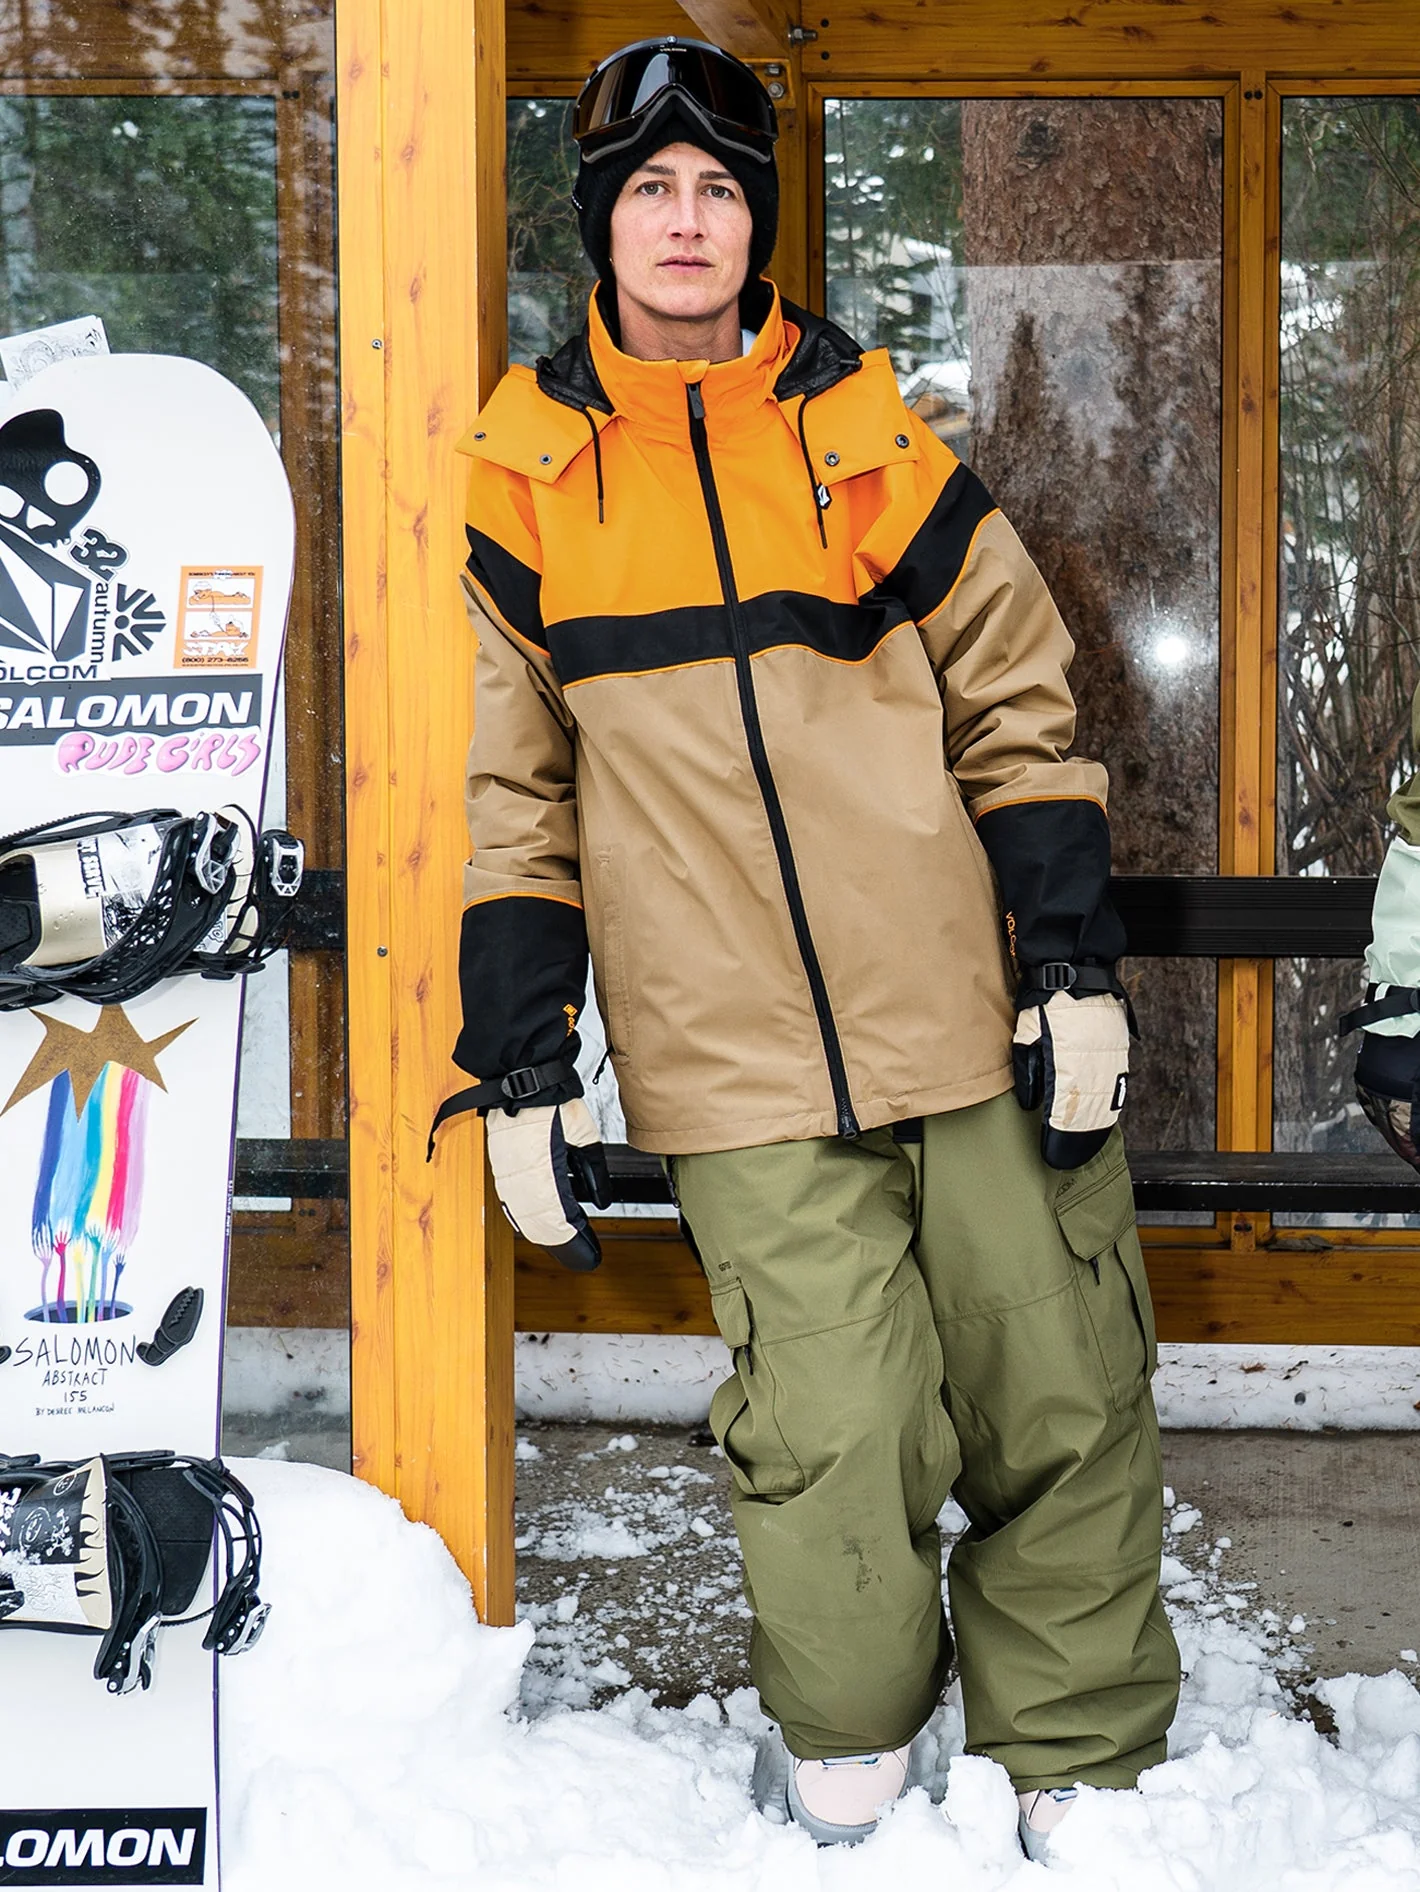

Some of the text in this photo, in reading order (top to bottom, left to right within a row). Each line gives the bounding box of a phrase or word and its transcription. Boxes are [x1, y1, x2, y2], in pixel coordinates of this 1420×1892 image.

[70, 528, 127, 581] 32
[90, 583, 110, 663] autumn
[182, 641, 248, 656] STAY
[0, 665, 97, 681] LCOM
[57, 732, 155, 775] RUDE
[13, 1334, 136, 1367] SALOMON
[42, 1368, 108, 1386] ABSTRACT
[64, 1390, 88, 1403] 155
[0, 1828, 197, 1867] OMON
